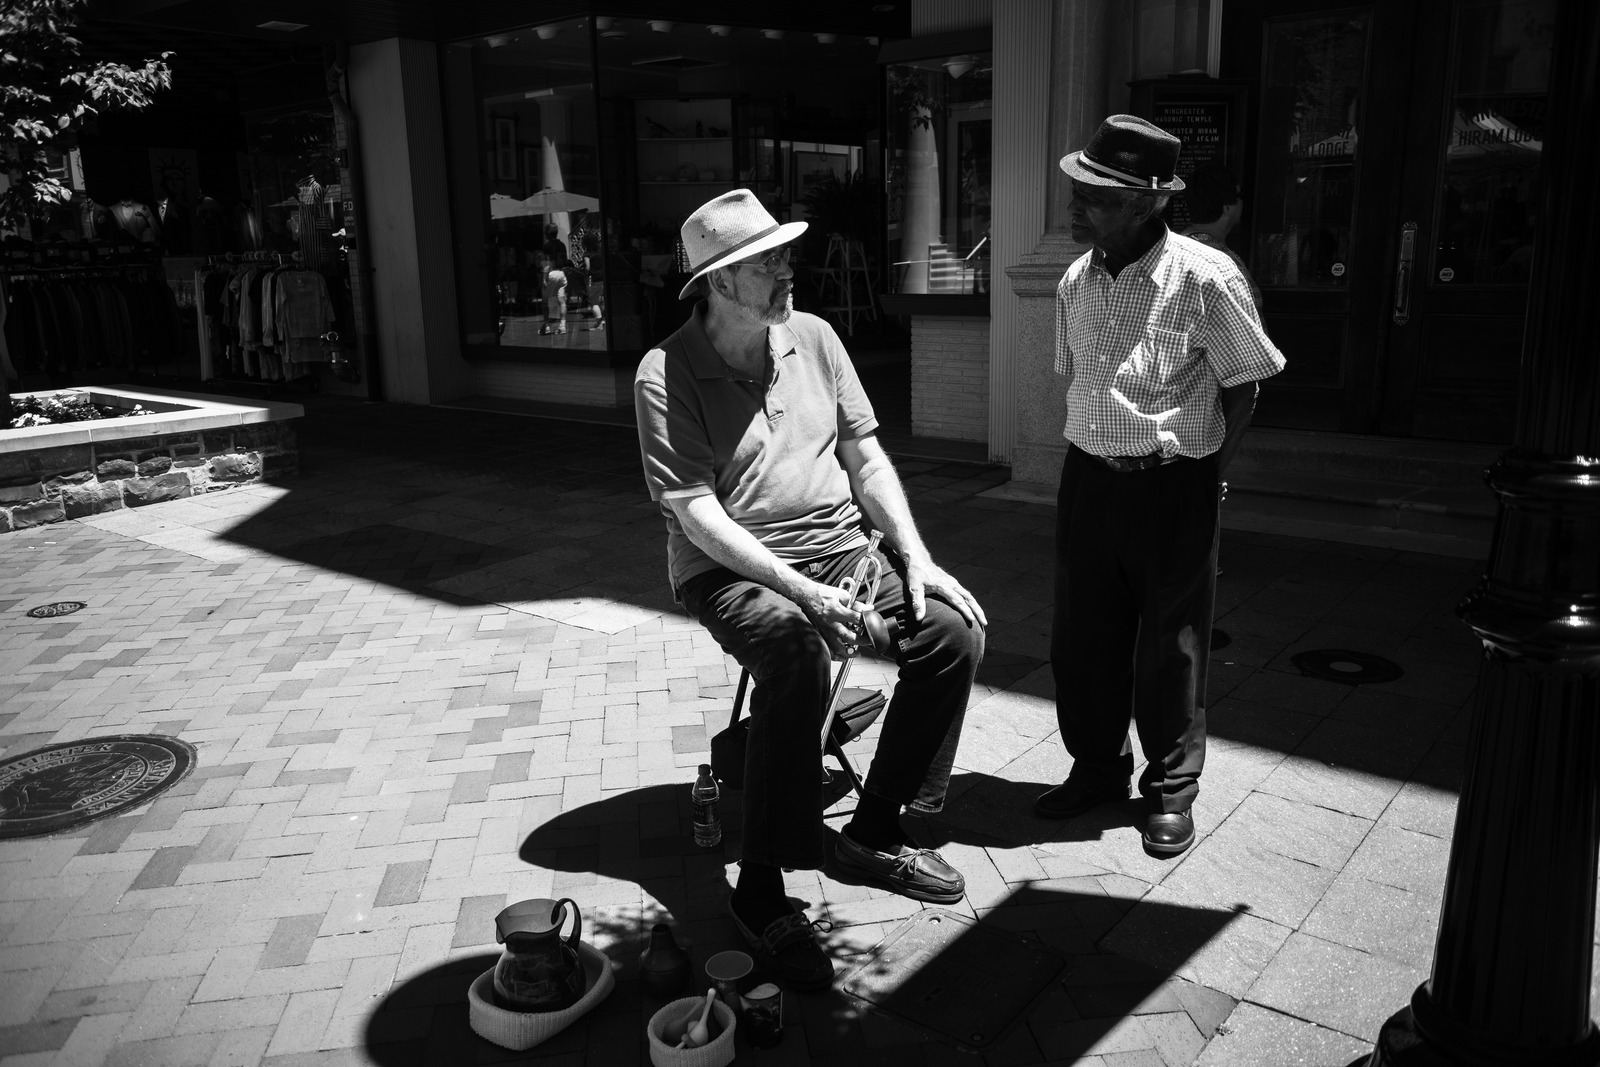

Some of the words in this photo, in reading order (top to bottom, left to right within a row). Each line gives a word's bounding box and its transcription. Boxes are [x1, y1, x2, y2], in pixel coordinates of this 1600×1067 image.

[1458, 99, 1547, 126] WINCHESTE
[1458, 129, 1504, 146] HIRAM
[1504, 126, 1544, 143] LODG
[86, 758, 173, 815] SANITARY
